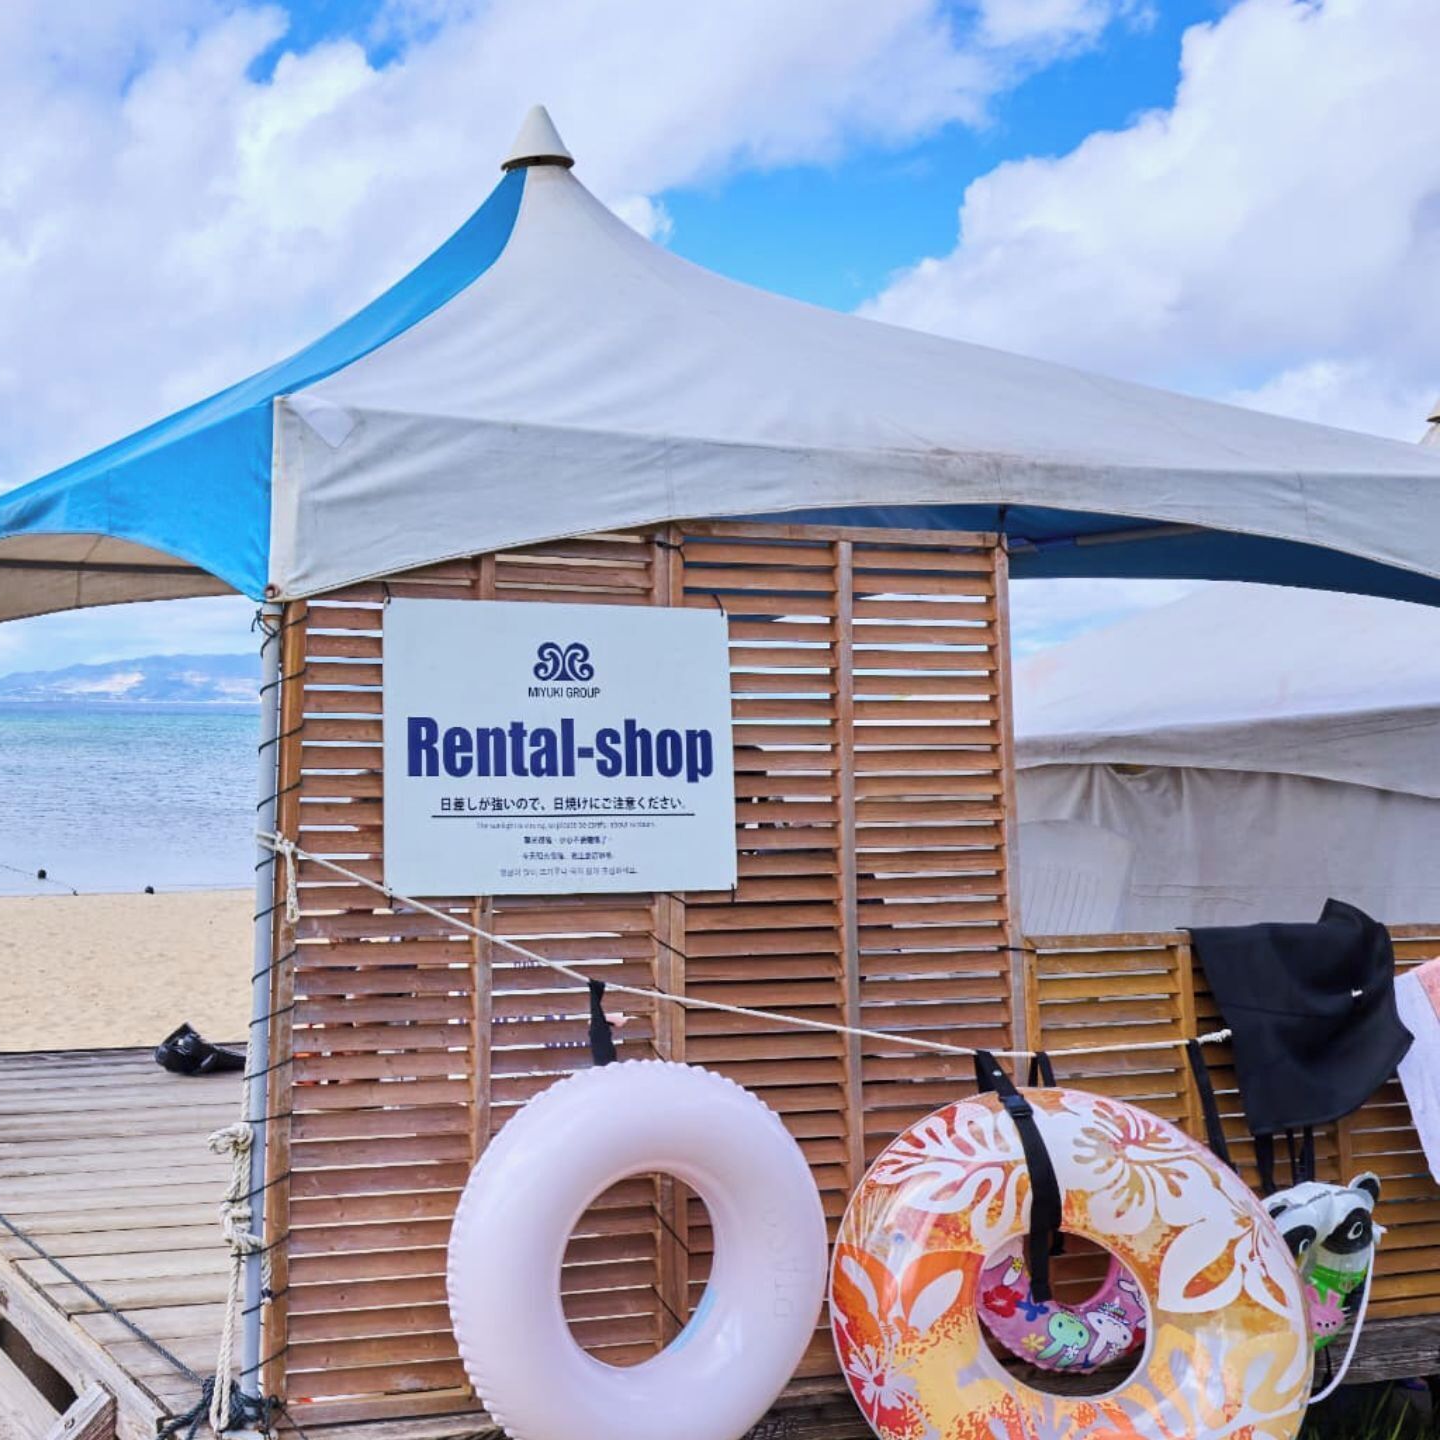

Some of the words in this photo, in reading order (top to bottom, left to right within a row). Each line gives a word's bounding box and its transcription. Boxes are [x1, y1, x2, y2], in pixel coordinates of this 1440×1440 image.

[528, 687, 563, 698] MIYUKI
[566, 687, 601, 698] GROUP
[407, 716, 714, 783] Rental-shop
